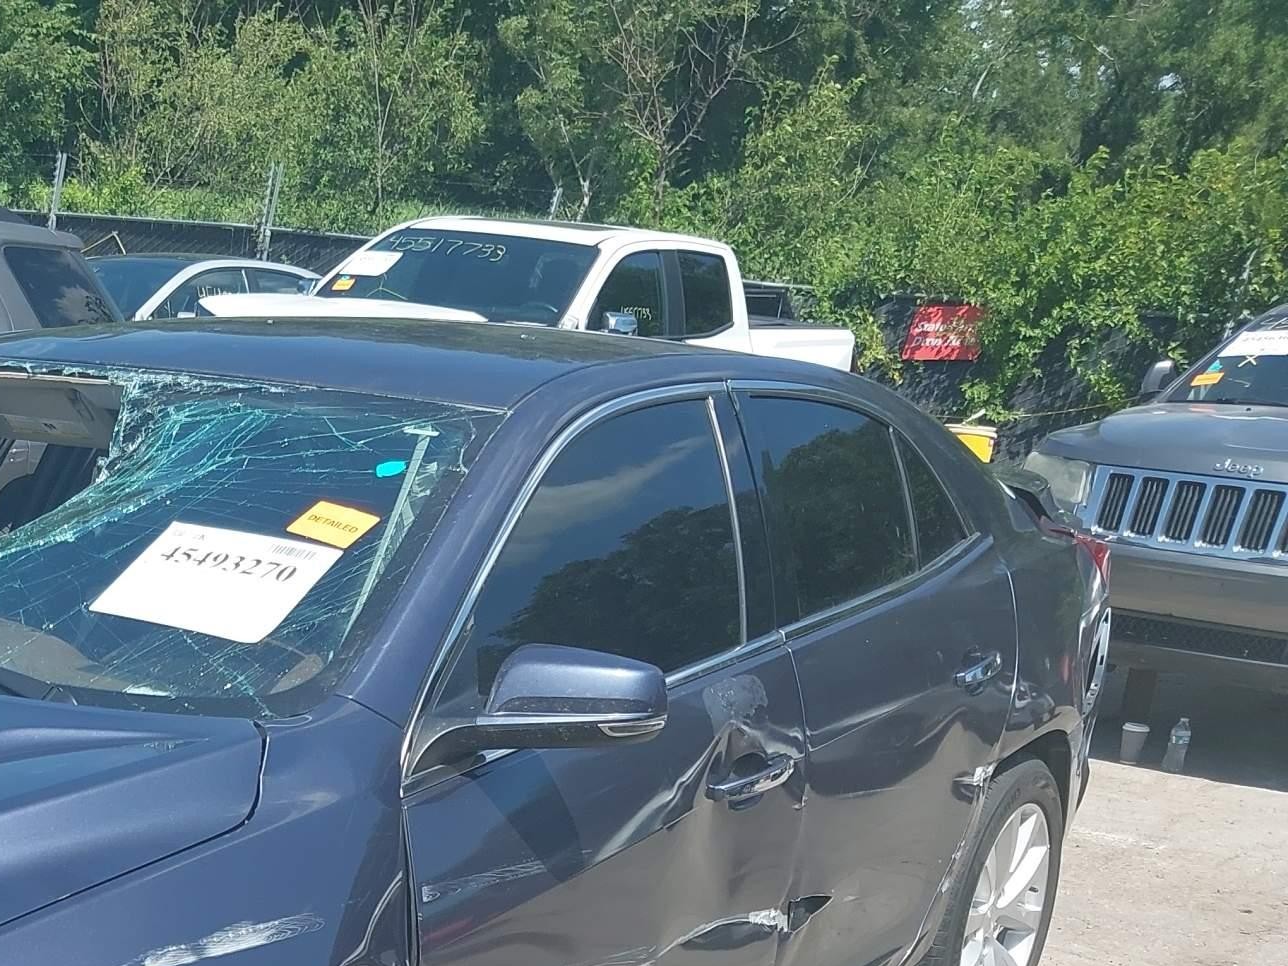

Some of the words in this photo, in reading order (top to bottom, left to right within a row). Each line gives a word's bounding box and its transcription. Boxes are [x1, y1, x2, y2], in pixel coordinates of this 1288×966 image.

[390, 235, 506, 261] 45517733
[1214, 458, 1264, 479] Jeep
[307, 514, 359, 534] DETAILED
[160, 545, 297, 582] 45493270
